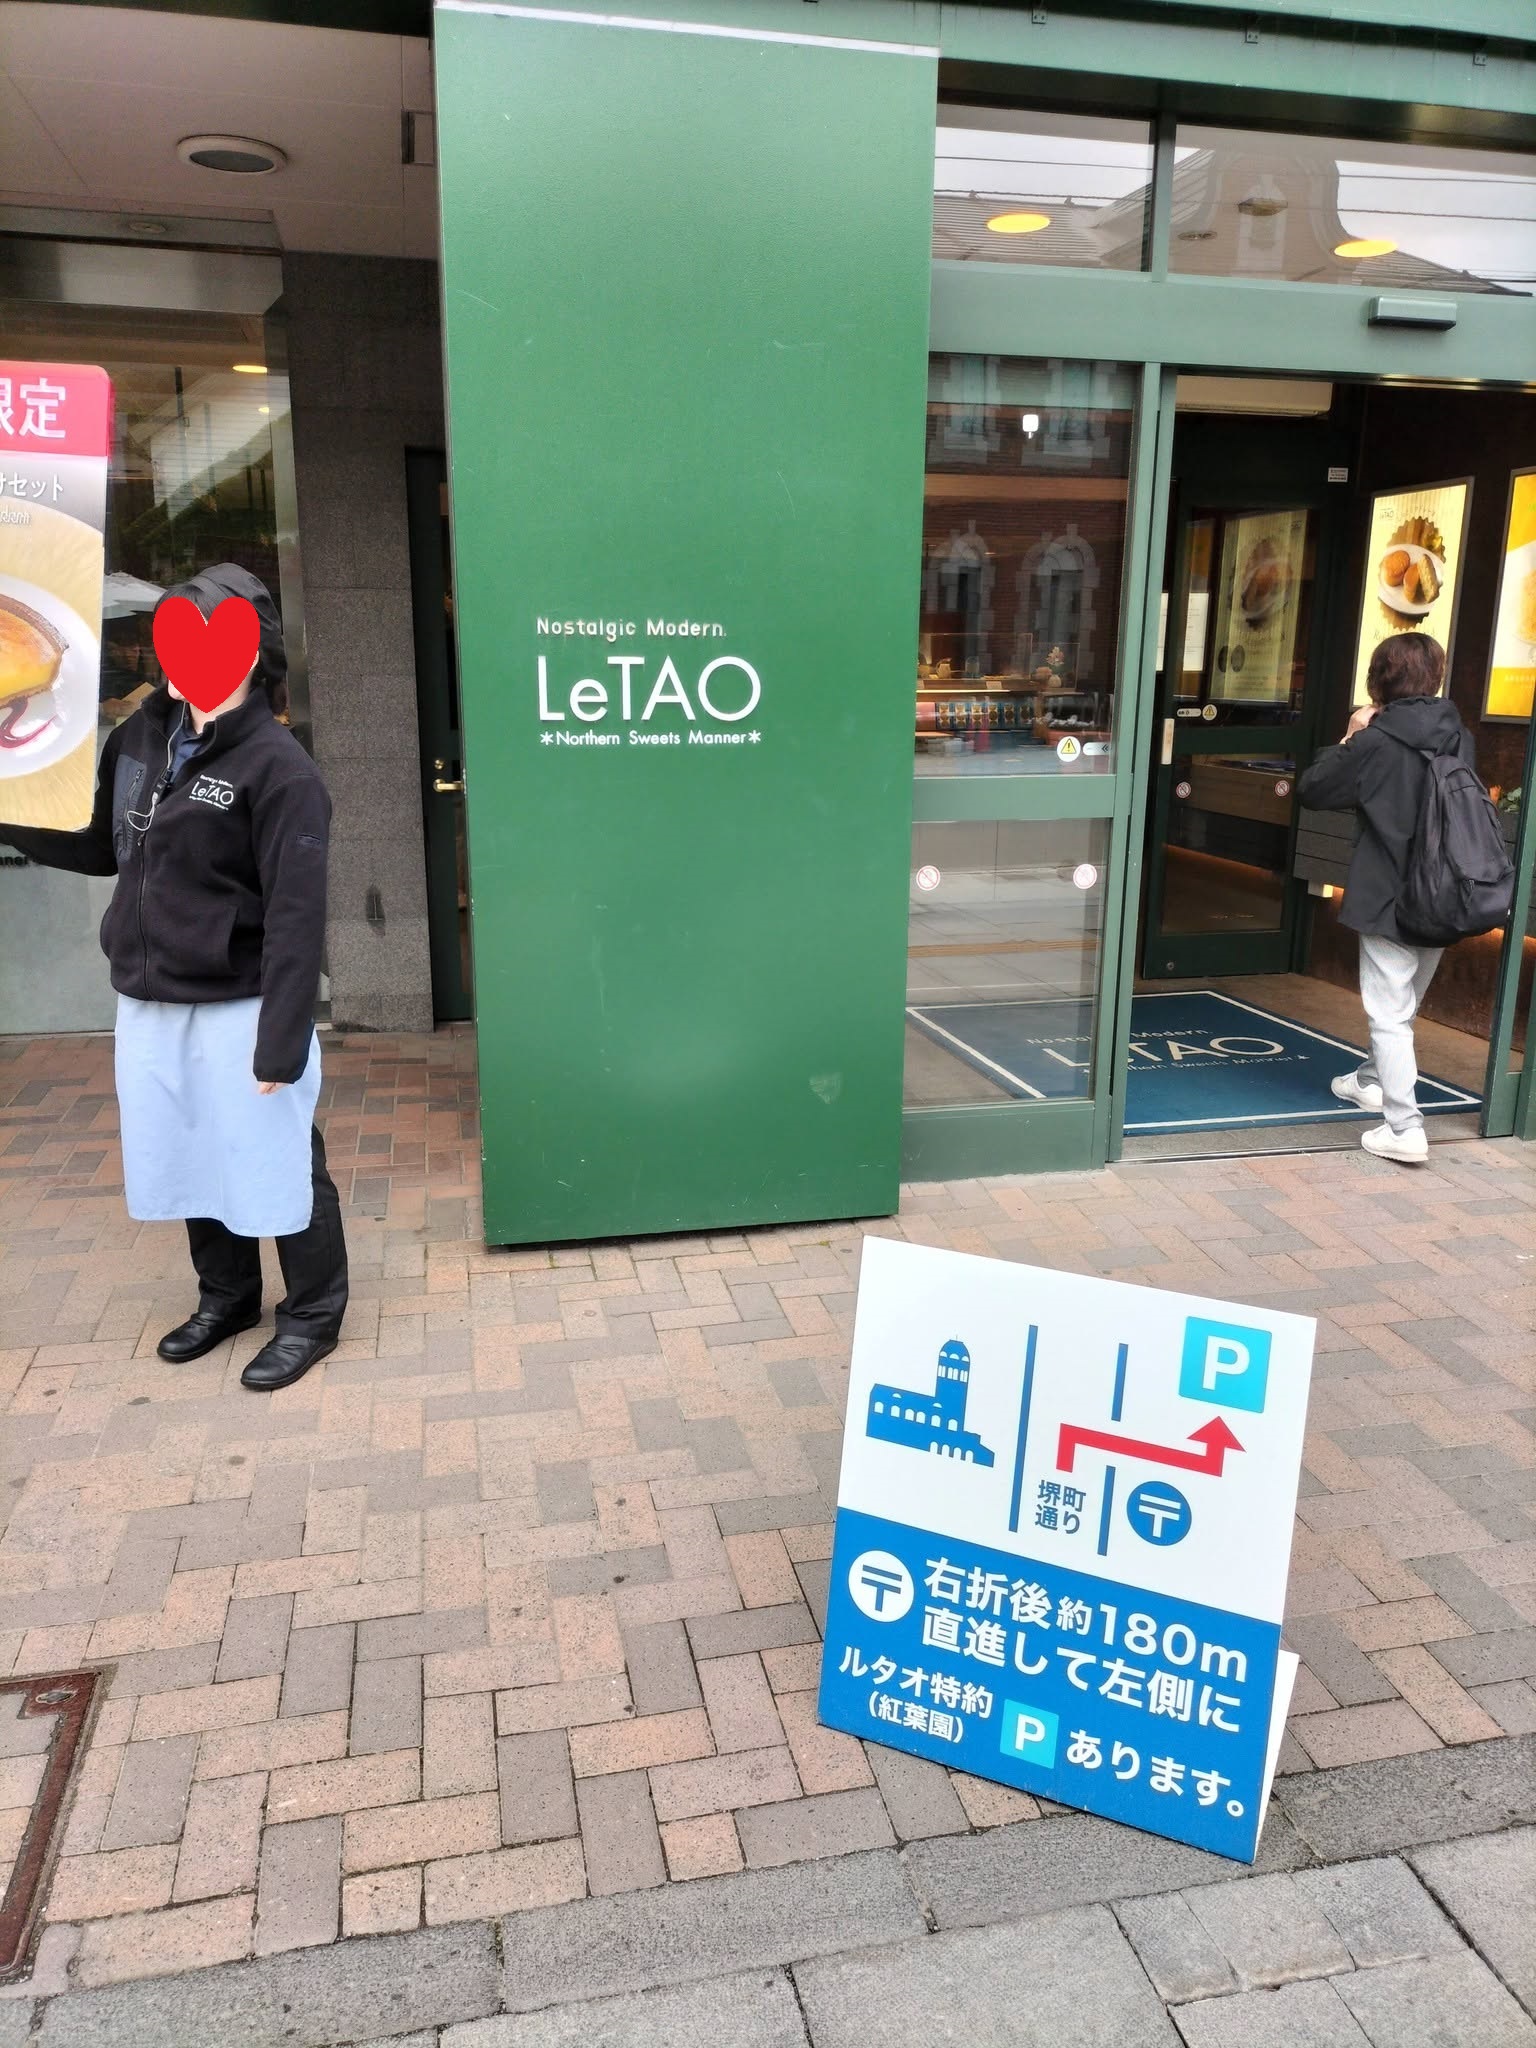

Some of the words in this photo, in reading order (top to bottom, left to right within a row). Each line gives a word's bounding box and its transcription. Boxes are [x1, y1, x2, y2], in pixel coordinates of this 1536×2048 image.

[537, 617, 636, 642] Nostalgic
[537, 655, 761, 721] LeTAO
[629, 730, 681, 745] Sweets
[191, 781, 234, 805] LeTAO
[1026, 1035, 1092, 1045] Nostal
[1042, 1036, 1285, 1067] LTAO
[1202, 1335, 1250, 1391] P
[1037, 1479, 1086, 1510] 堺町
[1034, 1504, 1082, 1536] 通り
[925, 1557, 1248, 1684] 右折後約180m
[840, 1646, 993, 1719] ルタオ特約
[922, 1608, 1242, 1734] 直進して左側に
[869, 1696, 964, 1743] (紅葉園)
[1066, 1730, 1245, 1818] あります。
